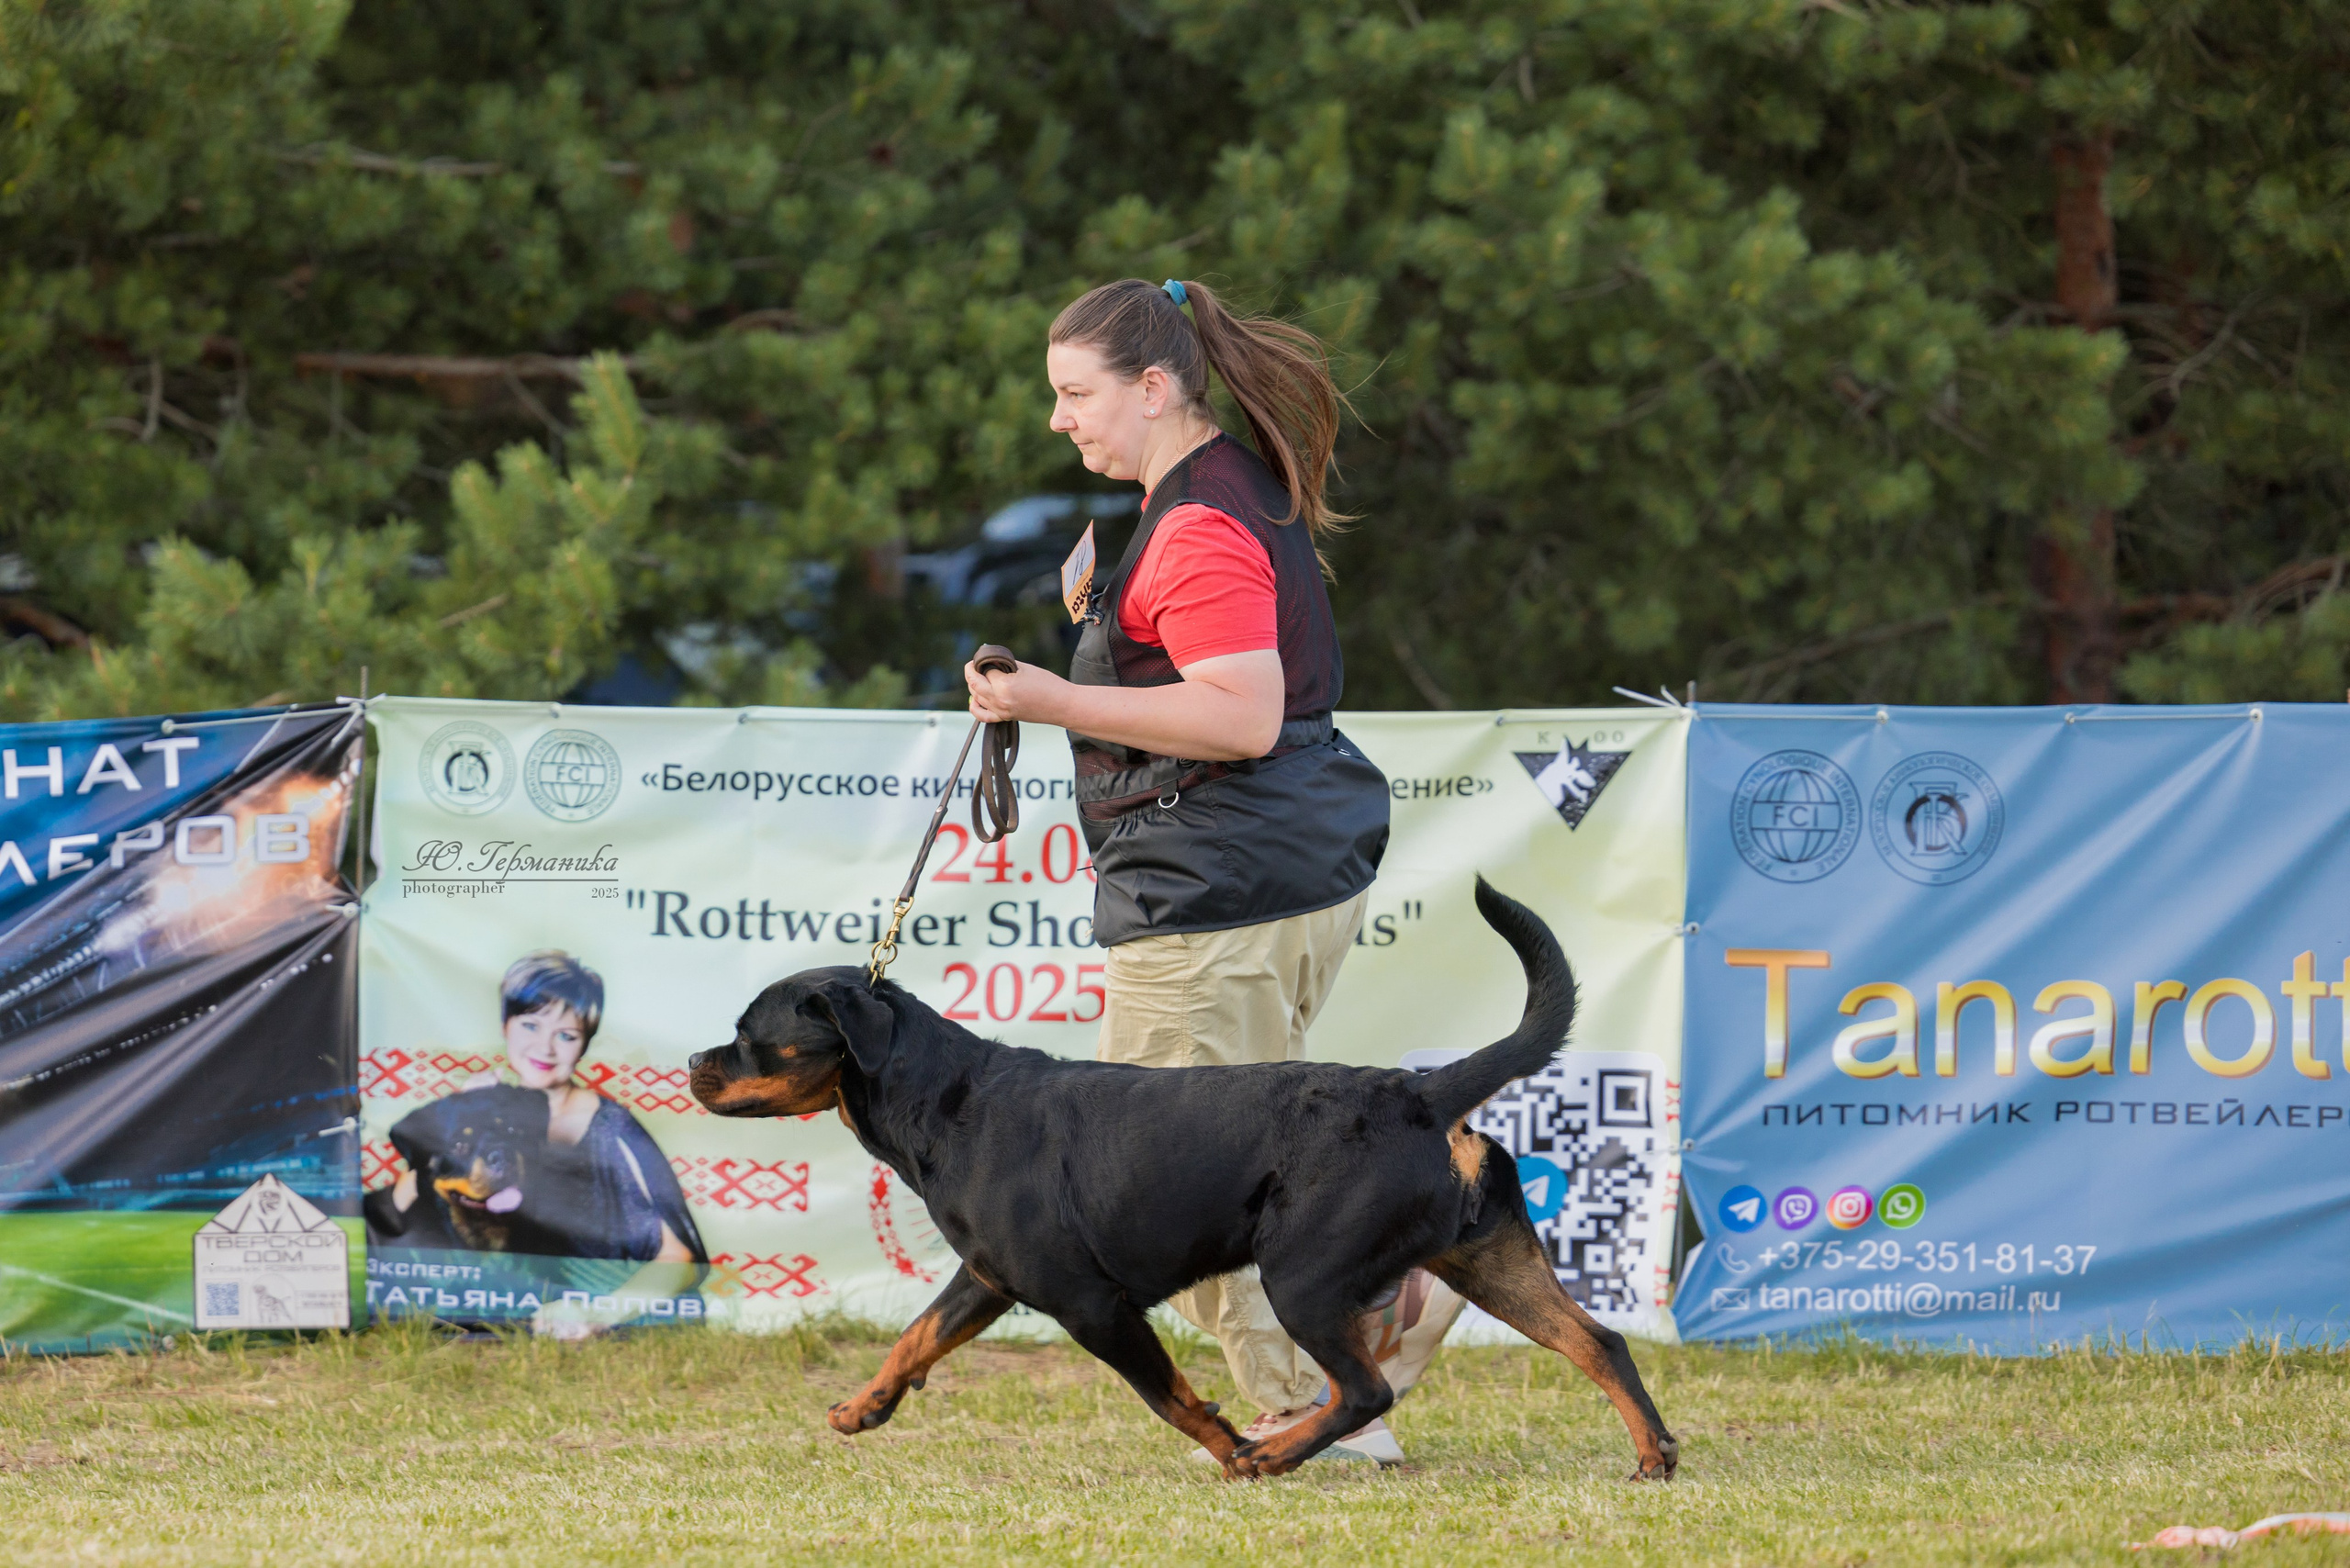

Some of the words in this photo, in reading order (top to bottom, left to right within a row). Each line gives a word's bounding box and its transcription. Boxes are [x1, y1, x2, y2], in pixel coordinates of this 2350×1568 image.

[3, 737, 199, 799] НАТ
[556, 765, 590, 782] FCI
[642, 763, 900, 801] «Белорусское
[1391, 776, 1494, 799] ение»
[1774, 804, 1818, 827] FCI
[931, 823, 1098, 884] 24.0
[988, 900, 1095, 947] Sho
[942, 961, 1106, 1023] 2025
[1762, 1102, 2030, 1126] ПИТОМНИК
[2054, 1098, 2350, 1129] РОТВЕЙЛЕР
[202, 1233, 342, 1249] ТВЕРСКОЙ
[243, 1250, 303, 1263] ДОМ
[1759, 1239, 2098, 1275] +375-29-351-81-37
[365, 1280, 543, 1309] ТАТЬЯНА
[1759, 1282, 2061, 1318] tanarotti@mail.ru
